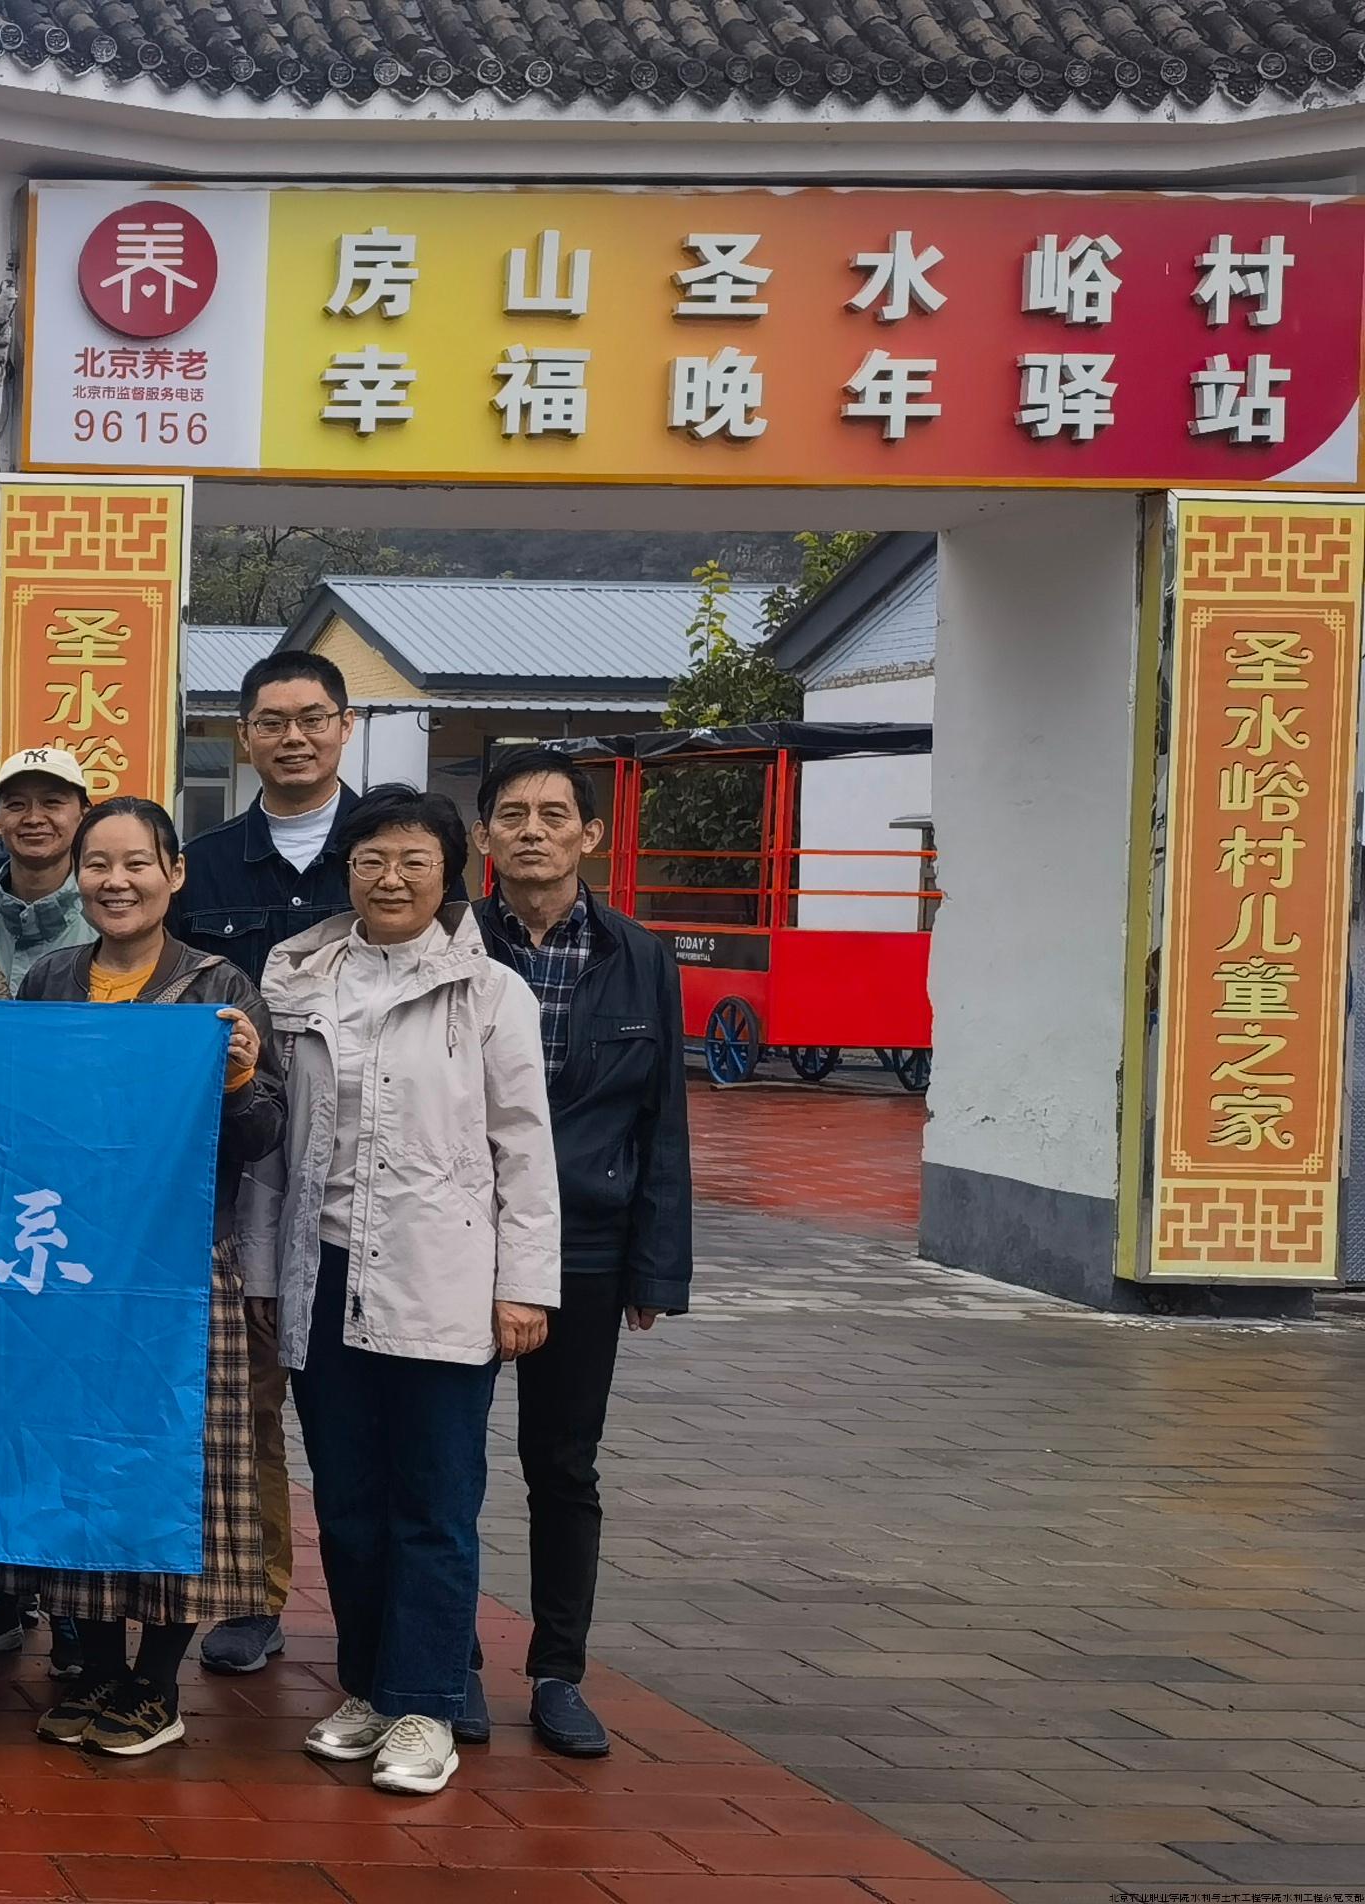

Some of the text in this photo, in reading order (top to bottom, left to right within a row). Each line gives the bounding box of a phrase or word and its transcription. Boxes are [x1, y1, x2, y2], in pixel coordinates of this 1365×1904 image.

[323, 226, 1295, 327] 房山圣水峪村
[72, 385, 204, 402] 北京市监督服务电话
[74, 347, 208, 380] 北京养老
[319, 344, 1291, 443] 幸福晚年驿站
[74, 409, 208, 445] 96156
[1207, 630, 1314, 1152] 圣水峪村儿童之家
